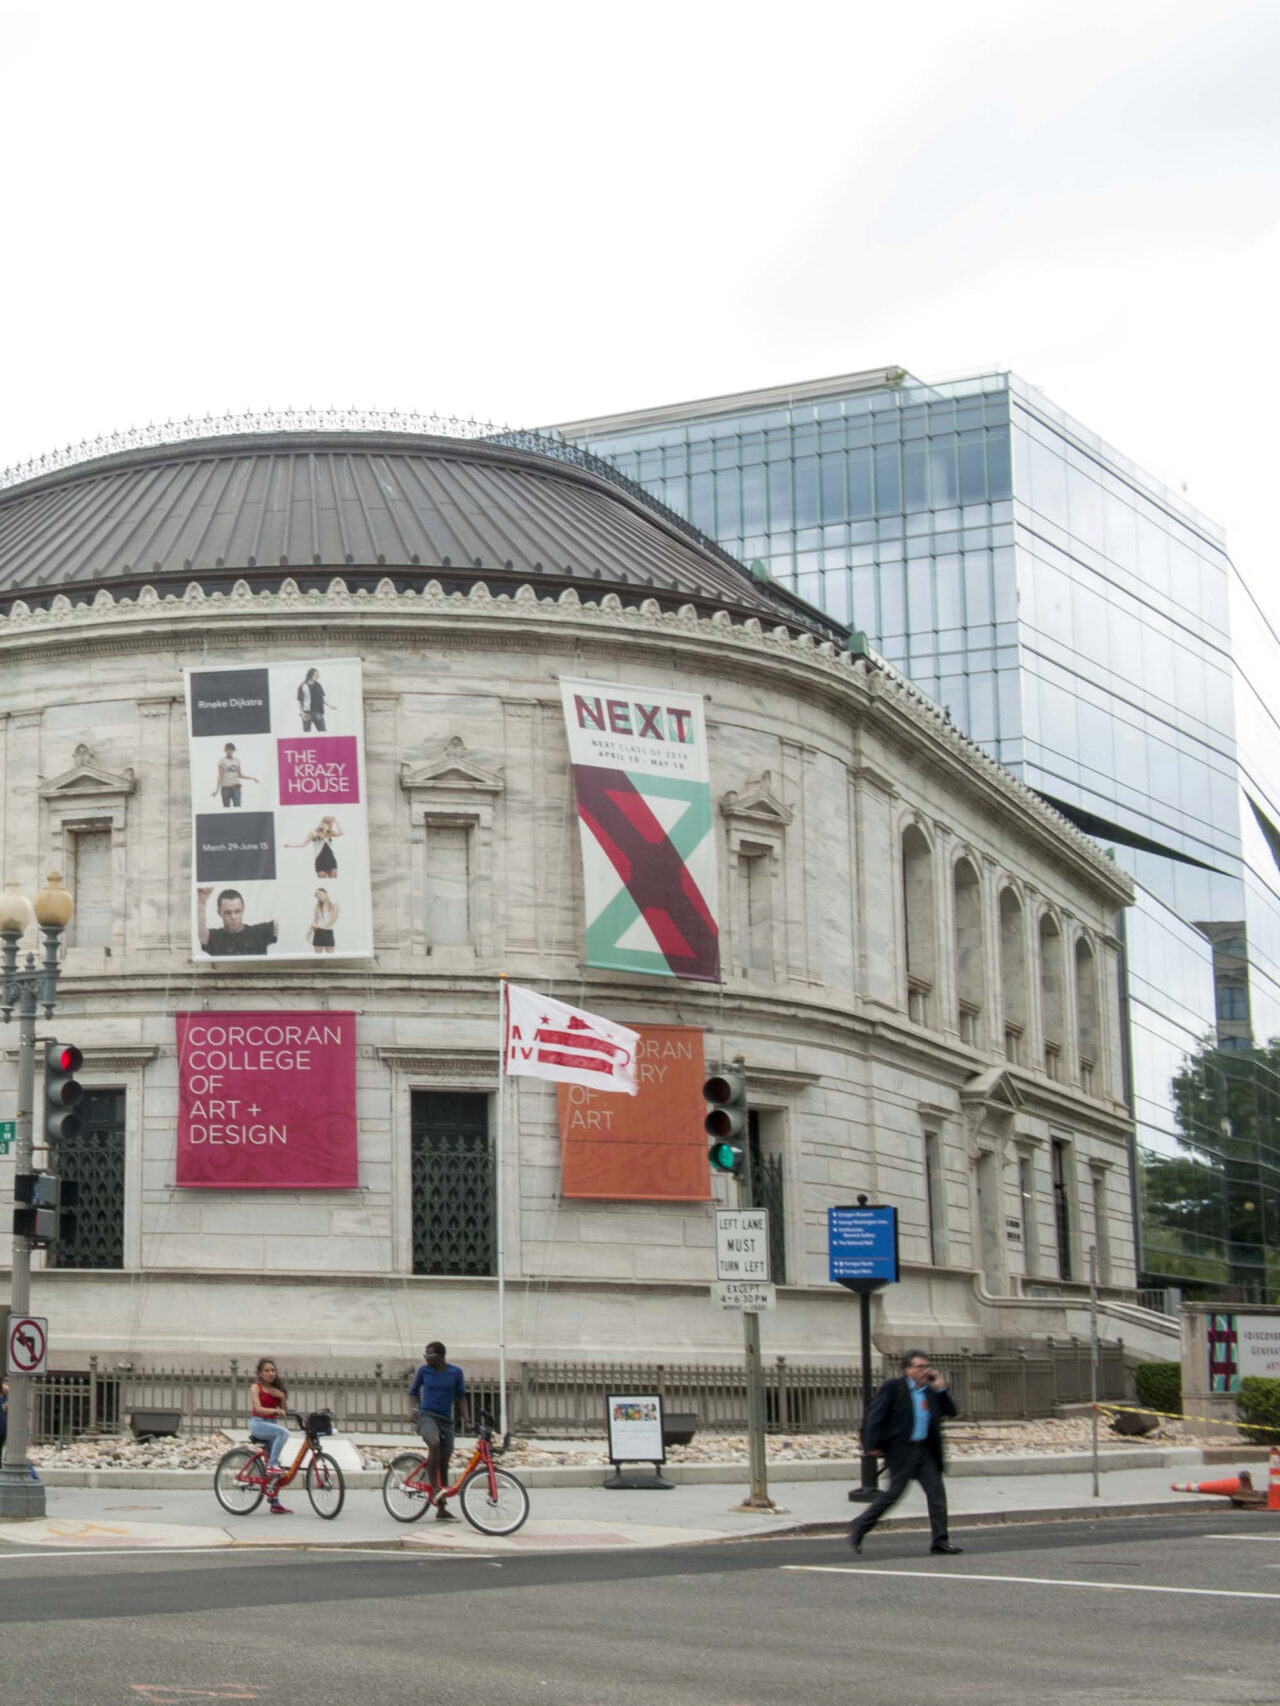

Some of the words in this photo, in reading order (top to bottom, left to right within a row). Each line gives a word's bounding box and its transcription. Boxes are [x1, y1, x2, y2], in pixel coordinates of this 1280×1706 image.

[198, 700, 228, 709] Rineke
[229, 698, 263, 709] Dijkstra
[573, 694, 695, 745] NEXT
[591, 740, 616, 749] NEXT
[619, 744, 647, 754] CLASS
[650, 748, 662, 756] OF
[283, 749, 317, 764] THE
[598, 751, 625, 761] APRIL
[651, 759, 669, 768] MAY
[294, 763, 347, 777] KRAZY
[288, 777, 351, 793] HOUSE
[202, 843, 226, 851] March
[260, 842, 269, 850] 15
[188, 1026, 342, 1046] CORCORAN
[636, 1039, 692, 1060] ORAN
[188, 1050, 312, 1070] COLLEGE
[189, 1075, 224, 1095] OF
[569, 1086, 599, 1105] OF
[189, 1100, 241, 1120] ART
[247, 1103, 262, 1117] +
[571, 1110, 614, 1130] ART
[189, 1124, 287, 1145] DESIGN
[720, 1218, 738, 1230] LEFT
[742, 1218, 764, 1230] LANE
[727, 1239, 755, 1252] MUST
[720, 1260, 739, 1272] TURN
[744, 1261, 764, 1272] LEFT
[727, 1284, 760, 1294] EXCEPT
